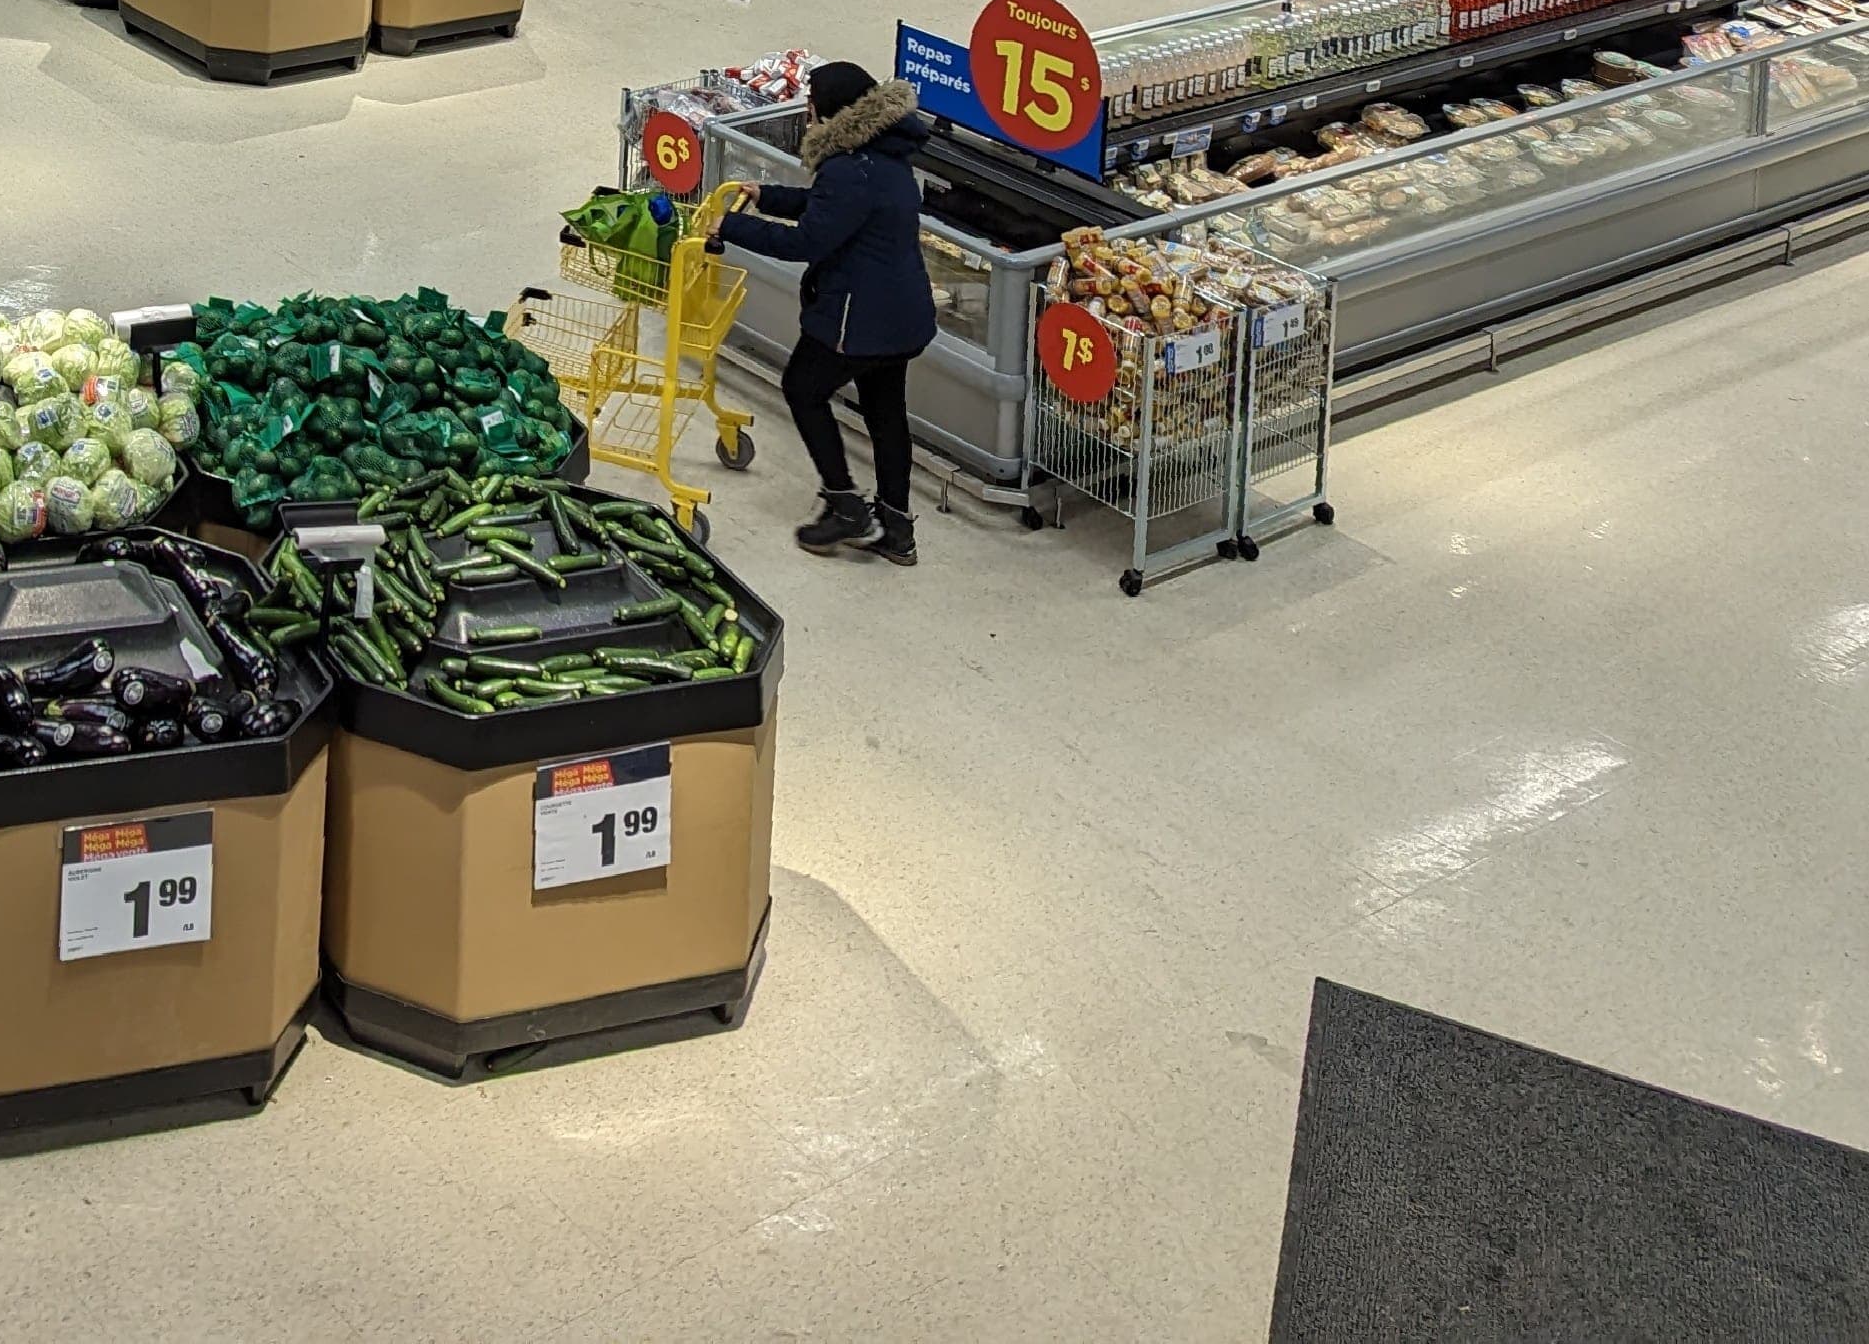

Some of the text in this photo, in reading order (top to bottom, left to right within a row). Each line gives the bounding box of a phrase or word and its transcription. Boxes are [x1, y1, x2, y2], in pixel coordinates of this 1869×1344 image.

[1007, 0, 1079, 40] Toujours
[907, 37, 953, 66] Repas
[905, 60, 972, 95] préparés
